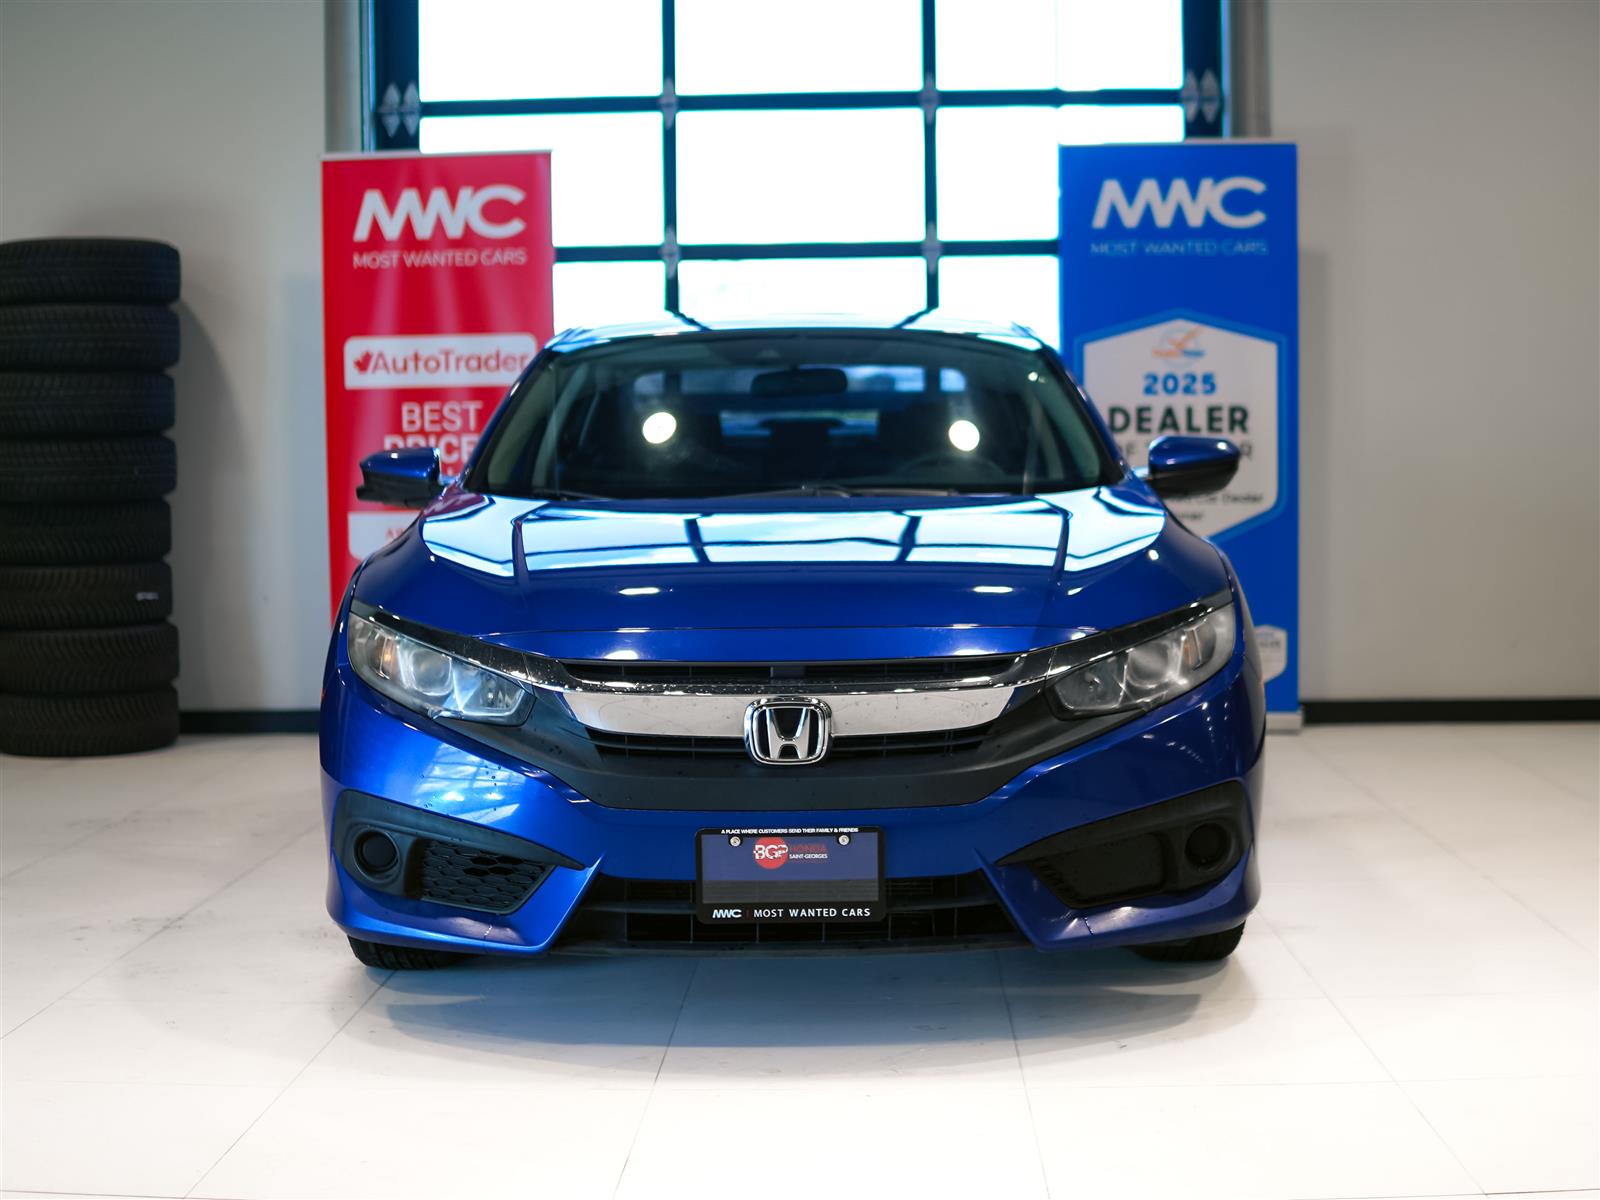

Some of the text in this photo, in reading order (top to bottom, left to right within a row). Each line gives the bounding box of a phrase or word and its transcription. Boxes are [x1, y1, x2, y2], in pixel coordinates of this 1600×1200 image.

[352, 247, 528, 270] MOST WANTED CARS
[1090, 239, 1268, 256] MOST WANTED CARS
[371, 349, 528, 374] AutoTrader
[1143, 372, 1217, 396] 2025
[401, 400, 483, 432] BEST
[1108, 405, 1249, 433] DEALER
[754, 908, 784, 918] MOST
[789, 908, 837, 917] WANTED
[842, 908, 870, 916] CARS
